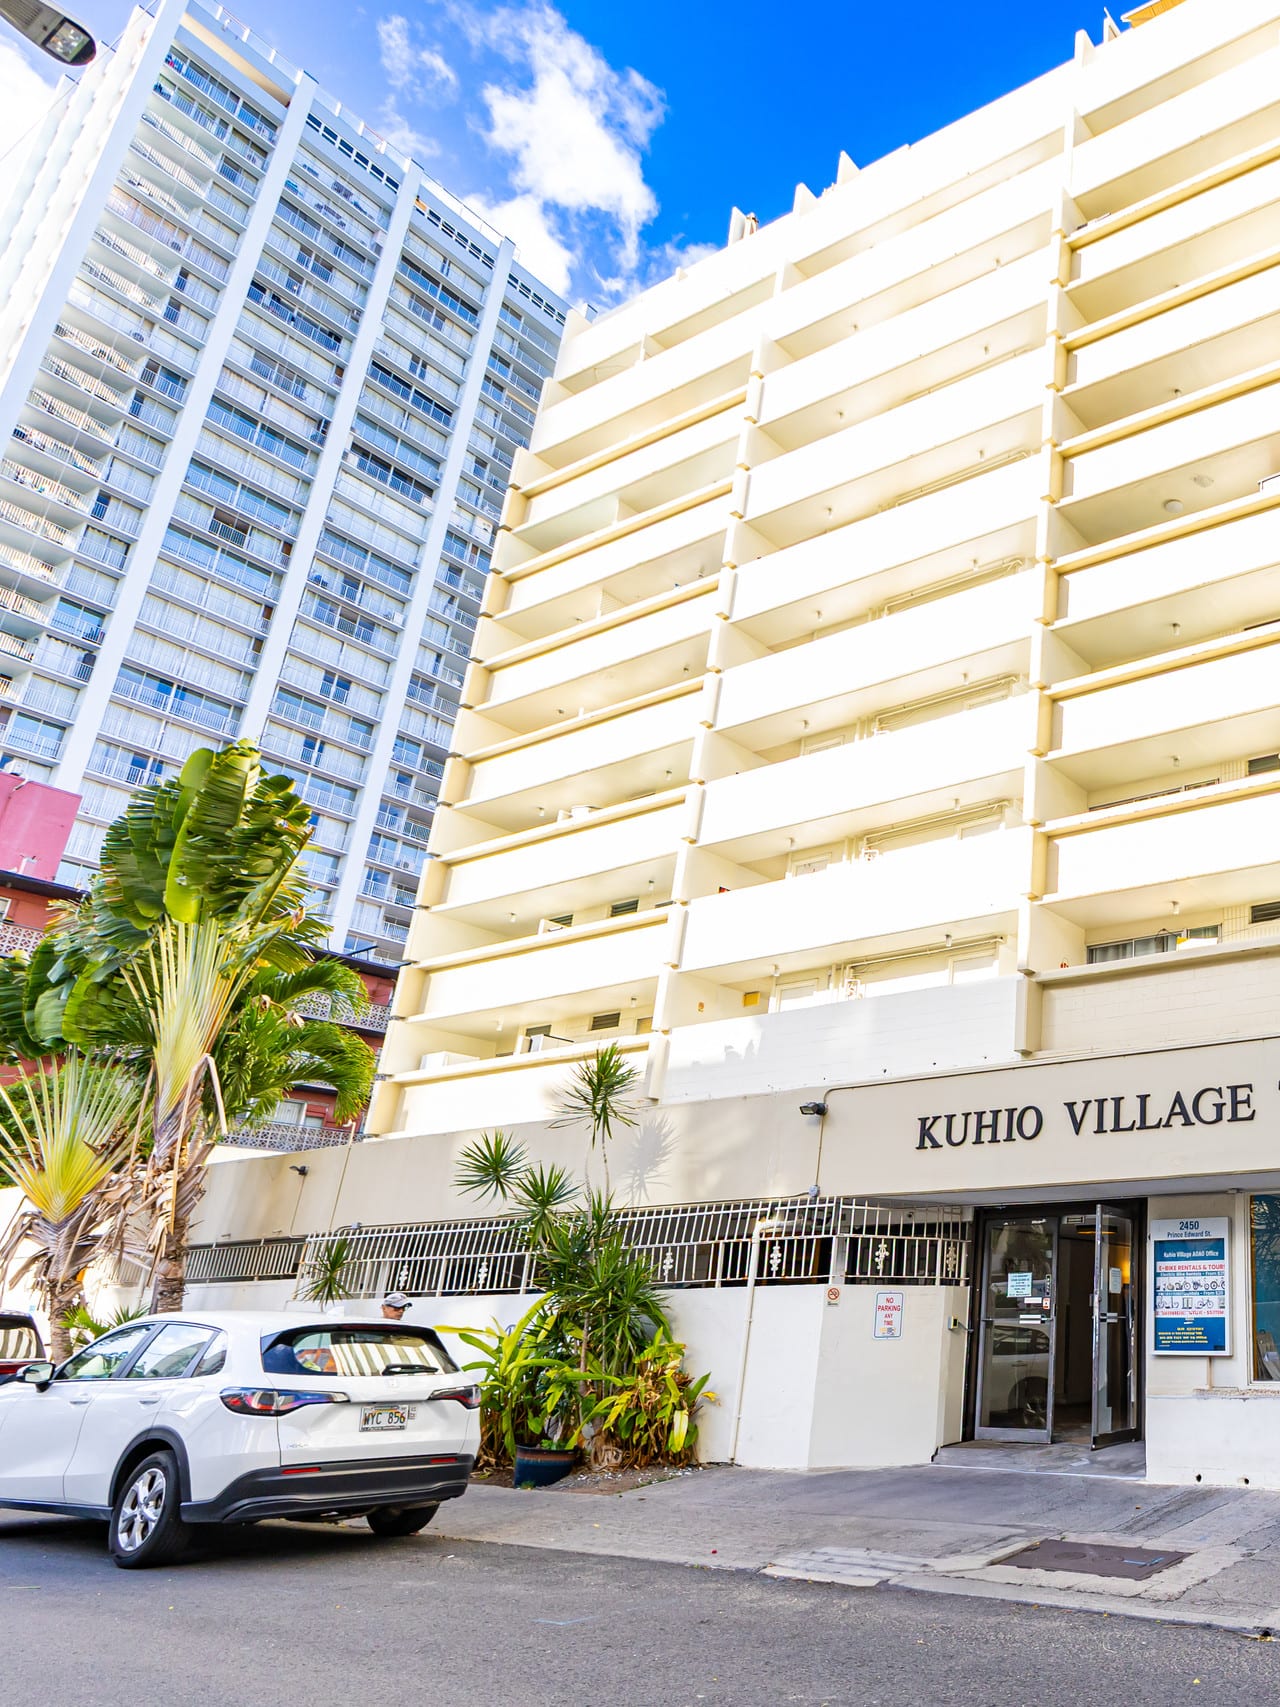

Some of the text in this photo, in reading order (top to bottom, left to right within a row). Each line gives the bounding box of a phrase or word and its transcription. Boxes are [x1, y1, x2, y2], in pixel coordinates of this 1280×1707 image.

[915, 1105, 1043, 1150] KUHIO
[1064, 1083, 1256, 1136] VILLAGE
[1179, 1221, 1199, 1230] 2450
[363, 1412, 382, 1425] WYC
[387, 1411, 405, 1425] 856
